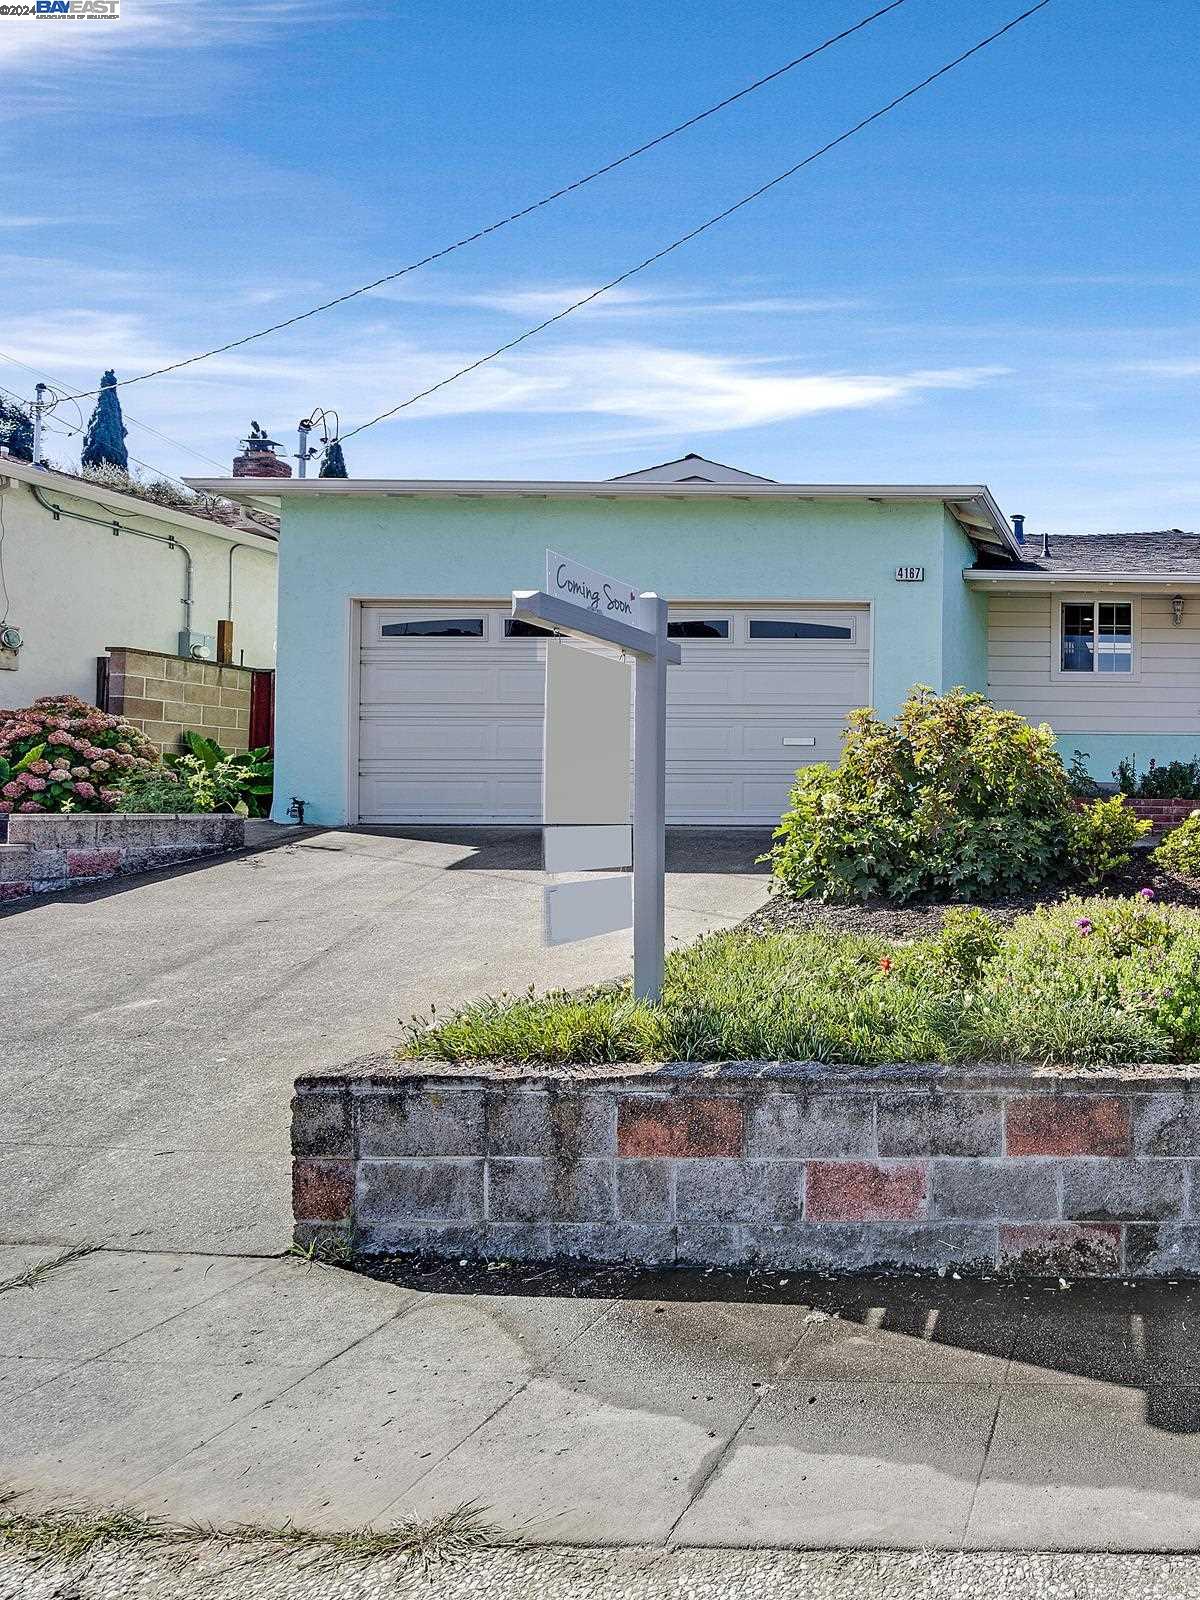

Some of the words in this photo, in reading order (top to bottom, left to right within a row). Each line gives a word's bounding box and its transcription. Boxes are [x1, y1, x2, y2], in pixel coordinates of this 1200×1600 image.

[898, 567, 921, 579] 4167
[557, 564, 600, 610] Coming
[603, 584, 632, 614] Soon
